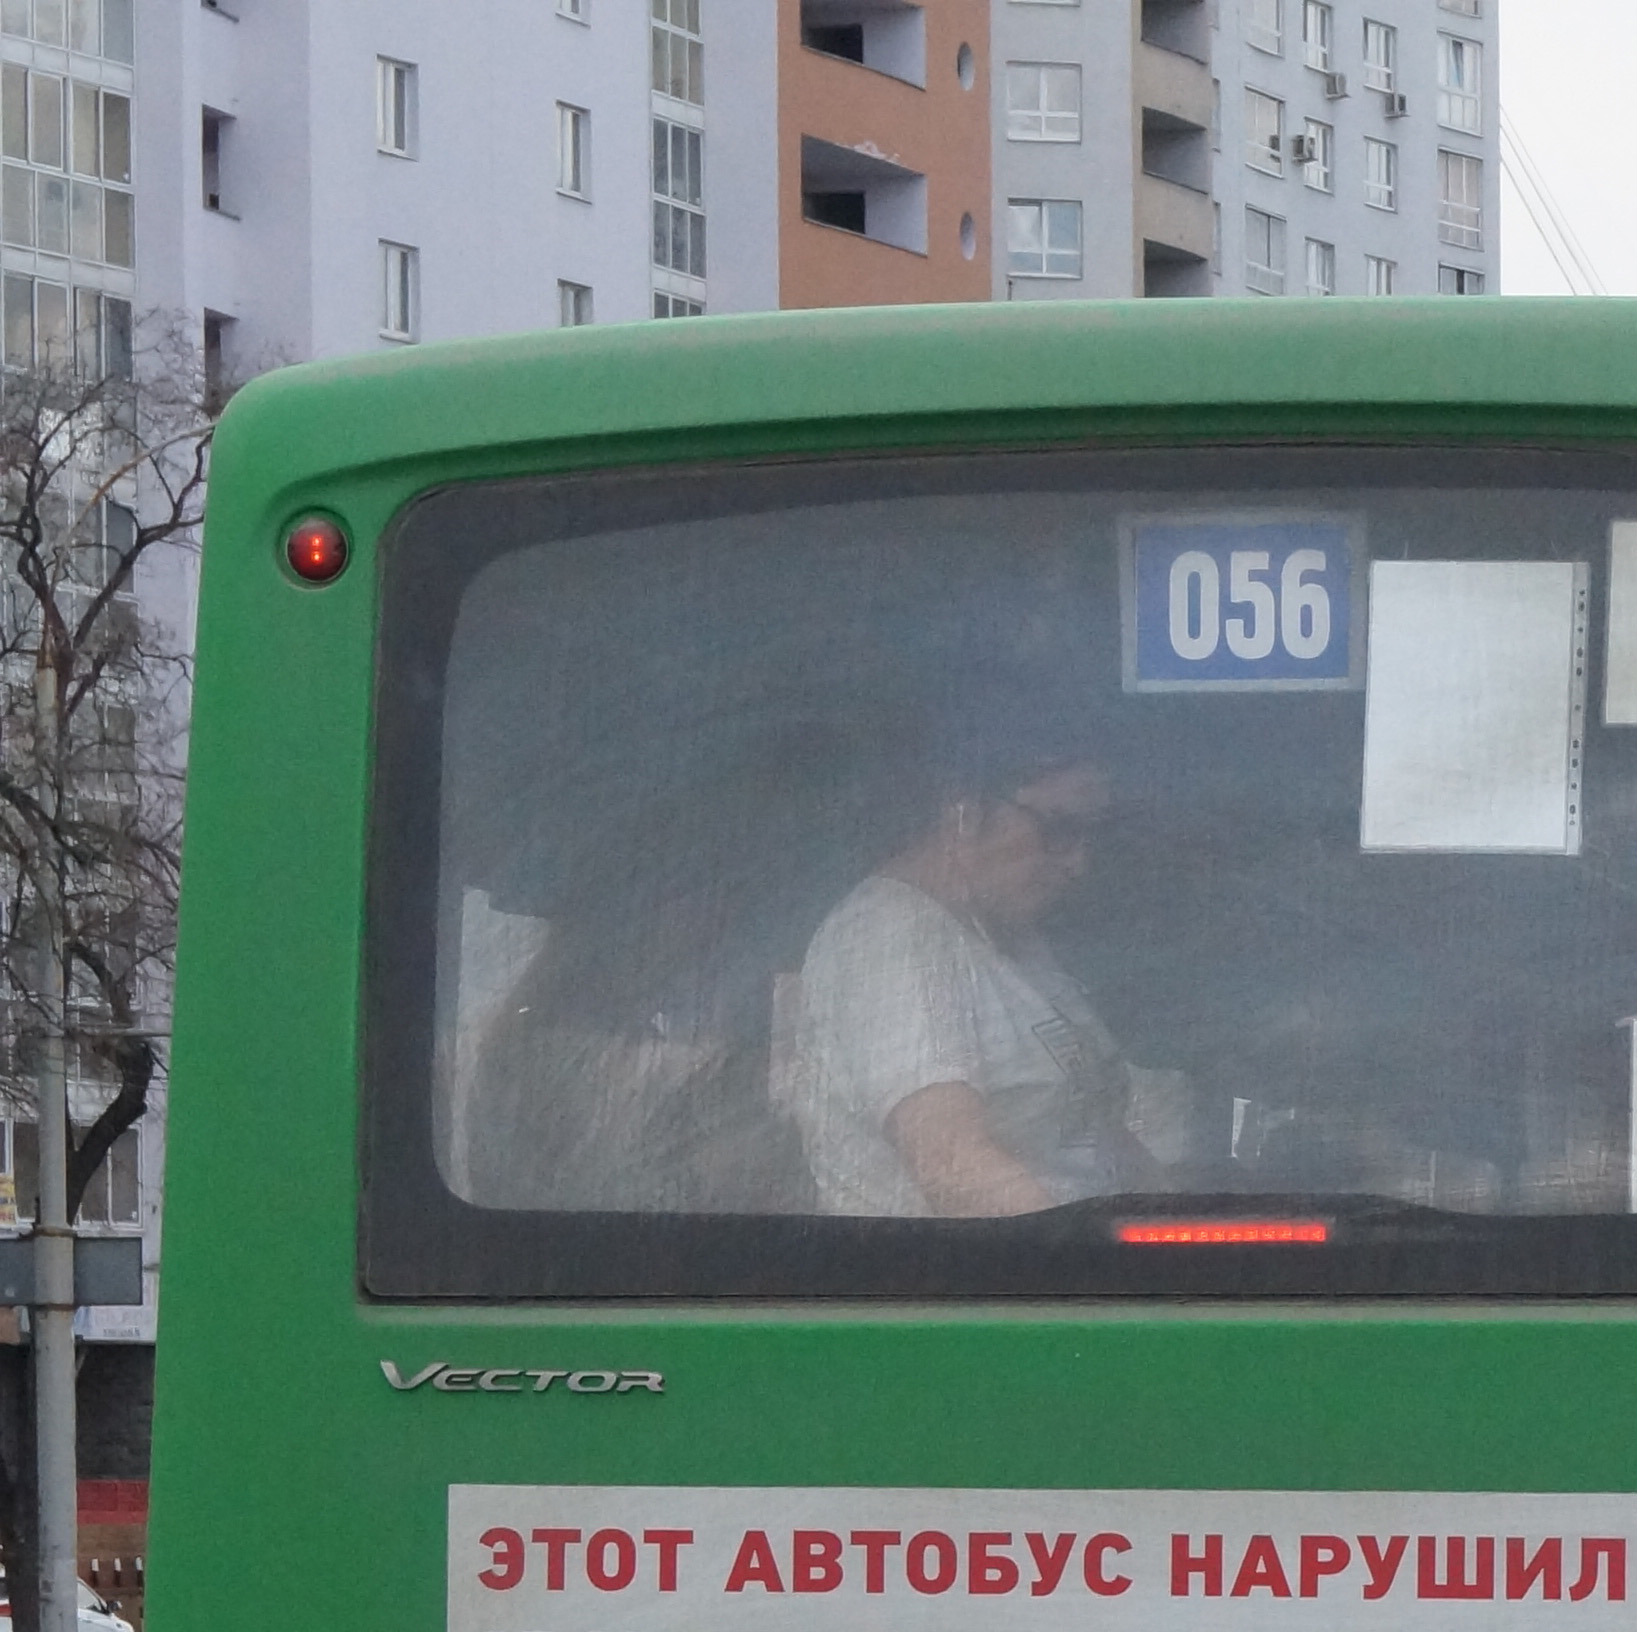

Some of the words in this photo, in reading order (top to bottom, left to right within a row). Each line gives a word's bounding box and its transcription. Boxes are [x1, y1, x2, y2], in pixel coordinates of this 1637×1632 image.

[1169, 549, 1331, 660] 056
[379, 1358, 666, 1393] VECTOR
[476, 1527, 695, 1592] ЭТОТ
[723, 1528, 1134, 1598] АВТОБУС
[1170, 1532, 1629, 1602] НАРУШИЛ
